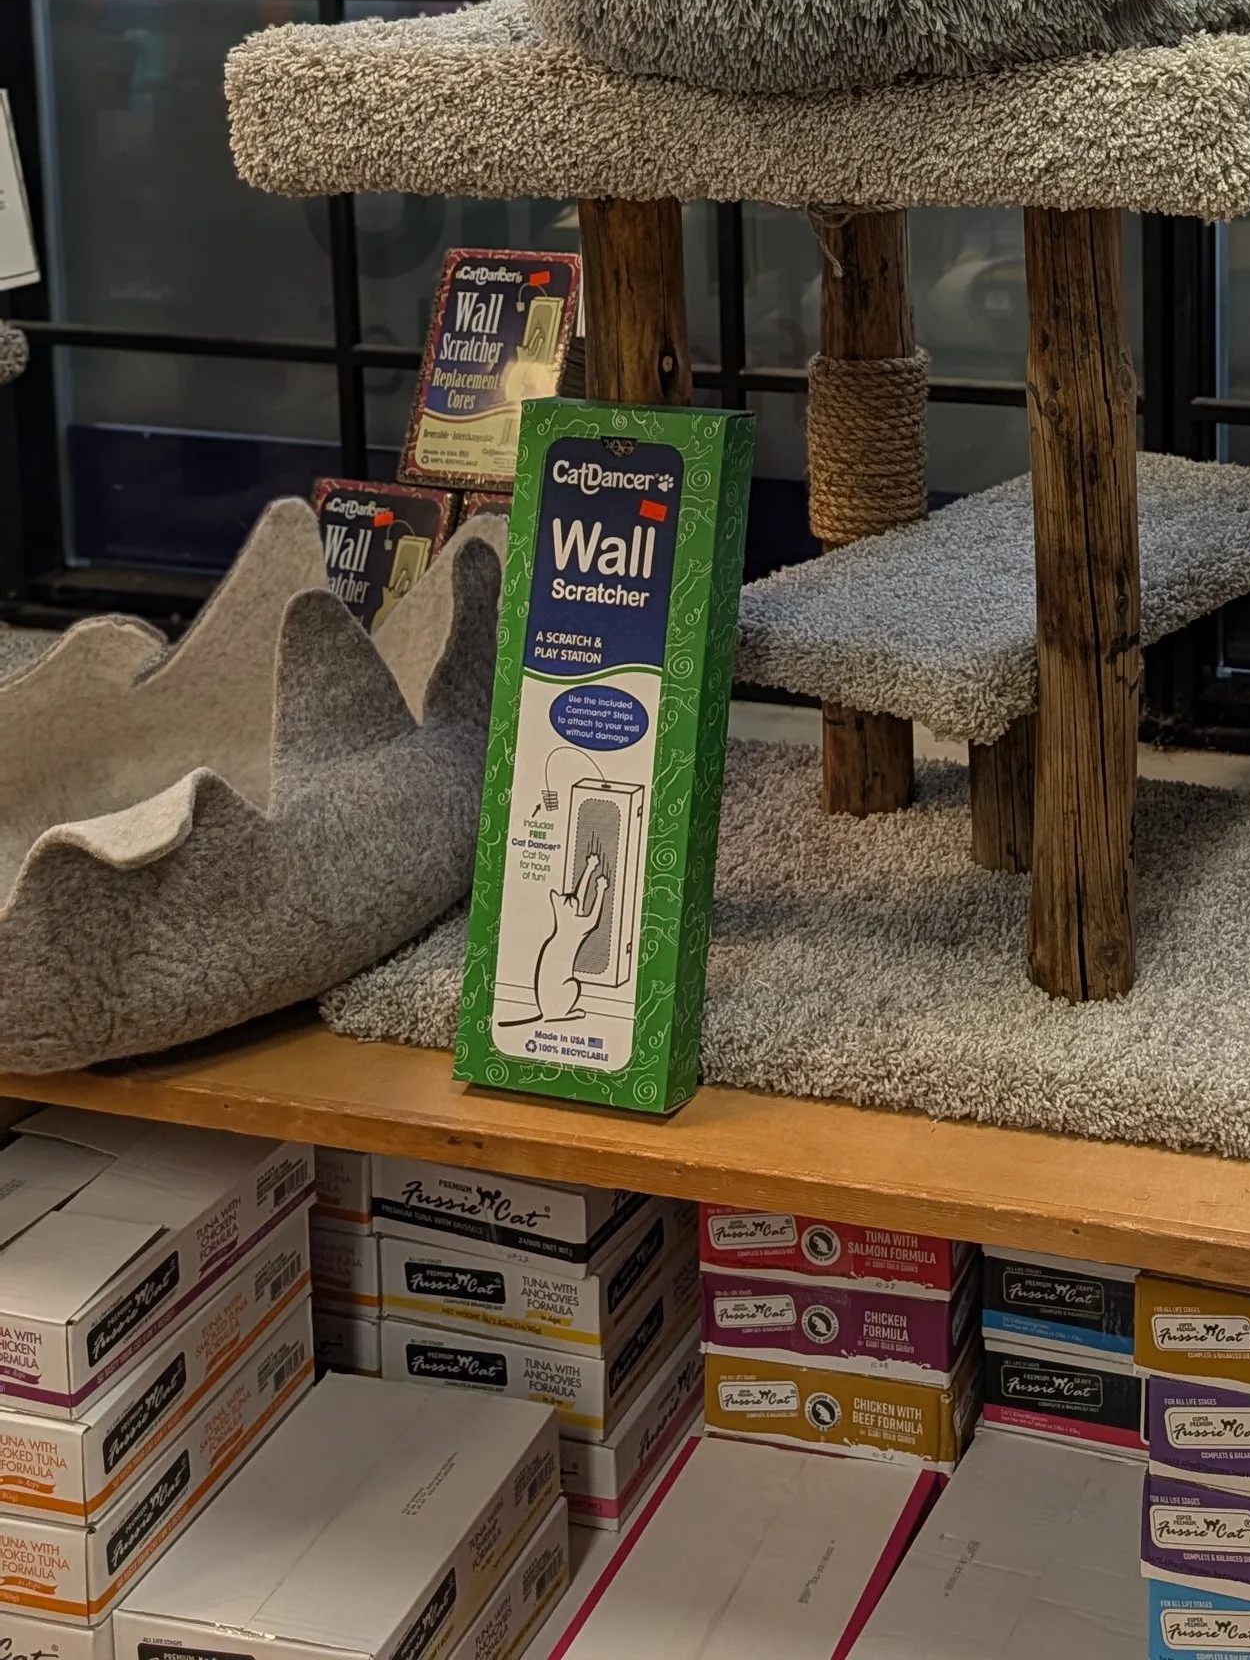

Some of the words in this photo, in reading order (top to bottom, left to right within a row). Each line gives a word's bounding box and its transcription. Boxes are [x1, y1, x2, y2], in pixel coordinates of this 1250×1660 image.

[455, 291, 505, 335] Wall
[439, 333, 504, 369] Scratcher
[431, 367, 499, 391] Replacement
[447, 389, 476, 411] Cores
[552, 459, 656, 495] CatDancer
[552, 517, 656, 579] Wall
[551, 578, 650, 609] Scratcher
[536, 631, 544, 642] A
[546, 632, 592, 648] SCRATCH
[594, 637, 602, 648] &
[534, 647, 558, 659] PLAY
[560, 650, 602, 664] STATION
[568, 694, 582, 704] Use
[583, 695, 596, 706] the
[598, 698, 633, 710] included
[557, 716, 566, 725] to
[567, 717, 593, 728] attach
[595, 720, 603, 729] to
[604, 722, 622, 731] your
[624, 722, 640, 733] wall
[613, 710, 633, 721] Strips
[565, 728, 593, 739] without
[595, 731, 629, 744] damage
[523, 819, 554, 830] Includes
[511, 838, 526, 846] Cat
[529, 830, 547, 839] FREE
[522, 850, 537, 859] Cat
[538, 852, 550, 863] Toy
[520, 860, 530, 869] for
[531, 861, 551, 872] hours
[522, 872, 530, 880] of
[534, 1030, 558, 1041] Made
[560, 1034, 568, 1043] in
[570, 1036, 585, 1045] USA
[538, 1043, 559, 1054] 100%
[561, 1047, 609, 1062] RECYCLABLE
[439, 1179, 472, 1194] PREMIUM
[401, 1180, 482, 1216] Fussie
[494, 1197, 551, 1228] Cat
[414, 1210, 433, 1223] TUNA
[433, 1215, 452, 1228] WITH
[865, 1230, 891, 1244] TUNA
[892, 1234, 918, 1249] WITH
[847, 1242, 888, 1261] SALMON
[889, 1247, 937, 1265] FORMULA
[410, 1273, 461, 1291] Fussie
[467, 1278, 502, 1296] Cat
[522, 1276, 550, 1289] TUNA
[552, 1282, 578, 1295] WITH
[521, 1287, 579, 1307] ANCHOVIES
[1009, 1282, 1058, 1301] Fussie
[1065, 1289, 1101, 1306] Cat
[527, 1297, 575, 1317] FORMULA
[864, 1310, 908, 1327] CHICKEN
[862, 1324, 909, 1342] FORMULA
[1158, 1327, 1209, 1345] Fussie
[1216, 1327, 1250, 1343] Cat
[523, 1368, 582, 1389] ANCHOVIES
[529, 1381, 577, 1399] FORMULA
[853, 1397, 896, 1417] CHICKEN
[896, 1405, 922, 1421] WITH
[852, 1410, 876, 1426] BEEF
[877, 1415, 924, 1436] FORMULA
[1173, 1422, 1225, 1440] Fussie
[36, 1452, 69, 1470] TUNA
[1157, 1521, 1208, 1539] Fussie
[2, 1561, 57, 1581] FORMULA
[37, 1553, 71, 1571] TUNA
[1169, 1623, 1220, 1640] Fussie
